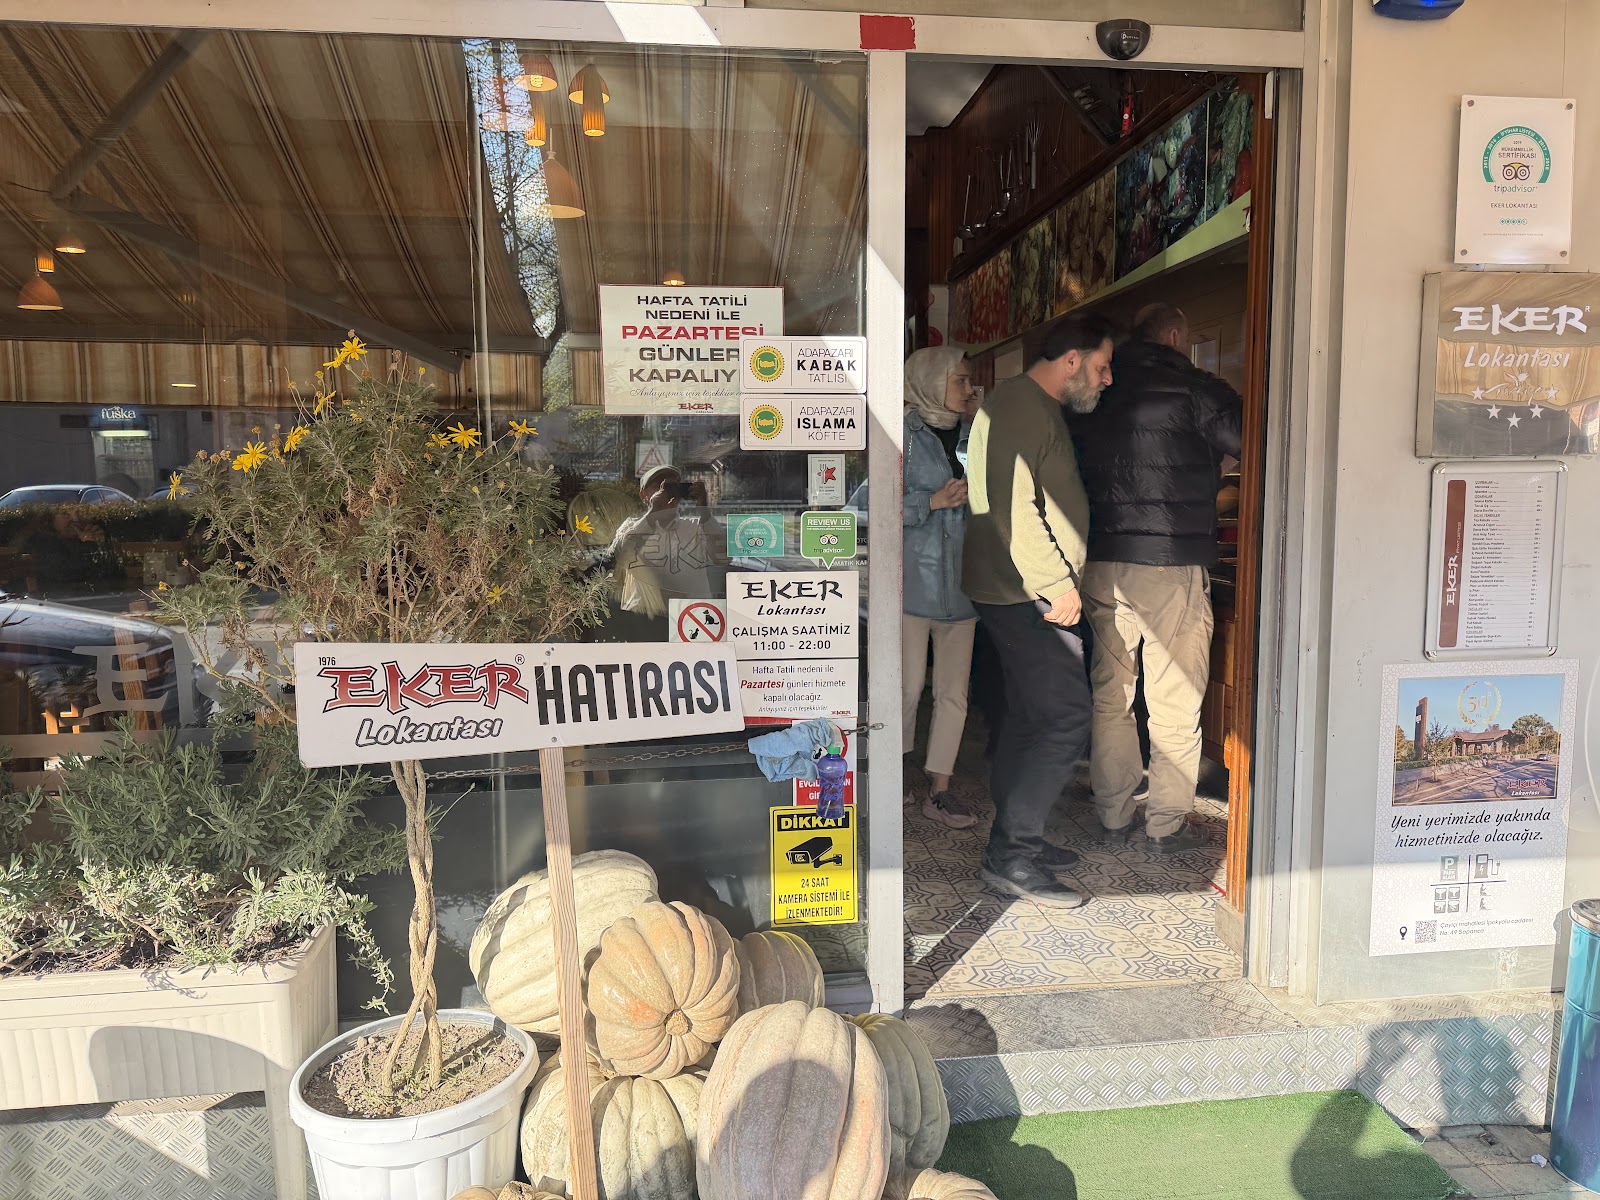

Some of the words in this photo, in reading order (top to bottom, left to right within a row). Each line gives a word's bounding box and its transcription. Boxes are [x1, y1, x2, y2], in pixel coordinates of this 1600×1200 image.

[1488, 139, 1497, 150] 2016
[1494, 184, 1536, 194] tripadvisor
[638, 296, 693, 306] HAFTA
[700, 295, 747, 306] TATİLİ
[646, 309, 710, 320] NEDENİ
[717, 309, 740, 320] İLE
[1452, 304, 1588, 336] EKER
[622, 324, 763, 340] PAZARTESİ
[640, 344, 740, 362] GÜNLER
[798, 348, 854, 358] ADAPAZARI
[1464, 346, 1571, 368] Lokantası
[797, 360, 857, 371] KABAK
[629, 369, 740, 383] KAPALIY
[808, 374, 847, 383] TATLISI
[800, 406, 855, 416] ADAPAZARI
[797, 418, 856, 429] ISLAMA
[808, 430, 846, 441] KÖFTE
[1446, 556, 1458, 606] EKER
[741, 580, 843, 602] EKER
[758, 605, 826, 616] Lokantası
[732, 626, 789, 638] ÇALIŞMA
[792, 623, 851, 635] SAATİMİZ
[754, 642, 786, 651] 11:00
[798, 640, 831, 650] 22:00
[318, 657, 336, 666] 1976
[752, 666, 774, 674] Hafta
[776, 666, 795, 674] Tatili
[798, 665, 823, 673] nedeni
[824, 665, 834, 673] ile
[740, 679, 785, 689] Pazartesi
[786, 680, 814, 690] günleri
[816, 679, 846, 688] hizmete
[317, 659, 529, 715] EKER
[534, 660, 731, 726] HATIRASI
[764, 694, 787, 703] kapalı
[788, 693, 823, 703] olacağız.
[355, 716, 504, 748] Lokantası
[1508, 779, 1547, 790] EKER
[781, 814, 845, 830] DİKKAT
[1392, 816, 1422, 832] Yeni
[1426, 810, 1491, 830] yerimizde
[1496, 808, 1551, 826] yakında
[1395, 830, 1480, 848] hizmetinizde
[1485, 828, 1543, 846] olacağız.
[801, 878, 809, 888] 24
[812, 877, 829, 887] SAAT
[778, 894, 808, 904] KAMERA
[810, 890, 838, 902] SİSTEMİ
[840, 889, 850, 900] İLE
[786, 904, 843, 919] İZLENMEKTEDİR!
